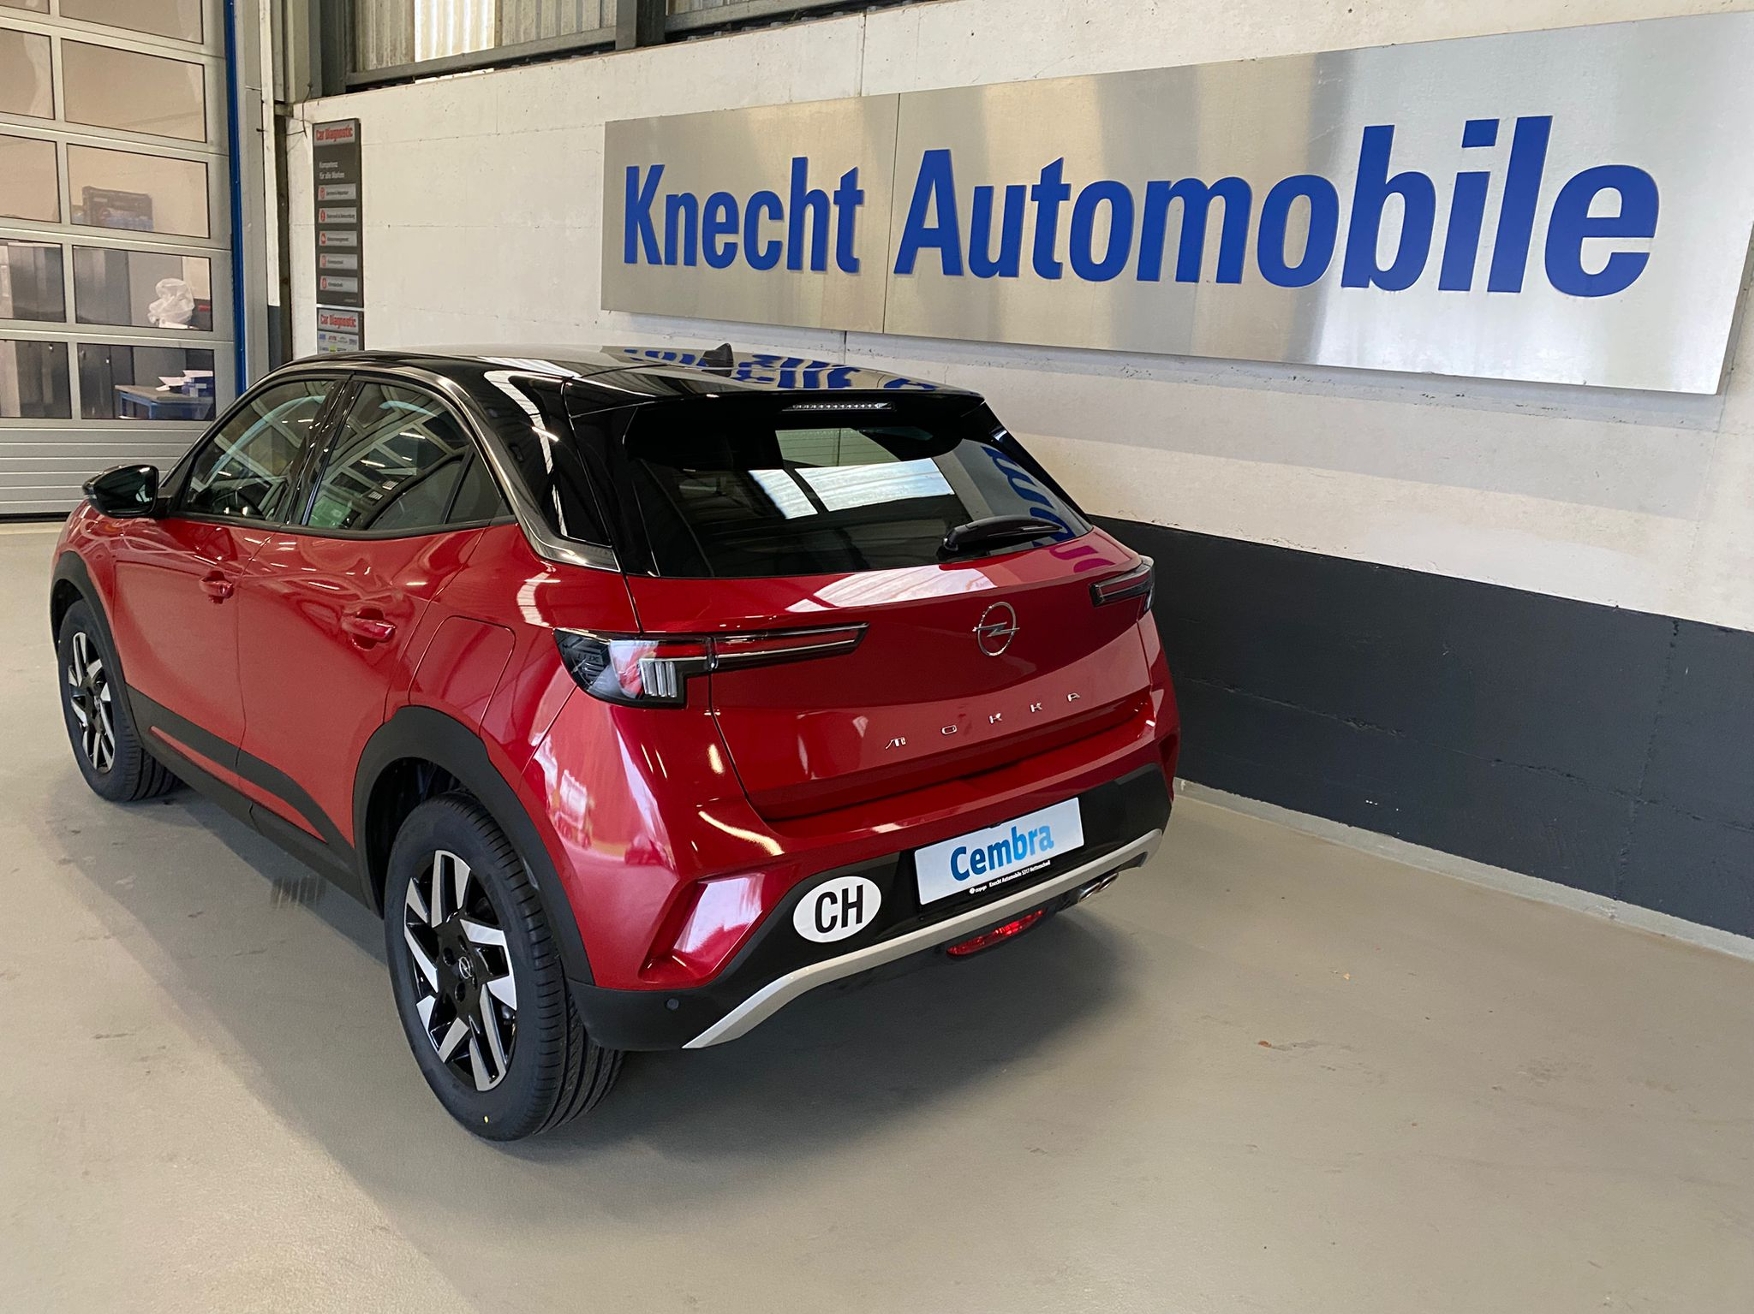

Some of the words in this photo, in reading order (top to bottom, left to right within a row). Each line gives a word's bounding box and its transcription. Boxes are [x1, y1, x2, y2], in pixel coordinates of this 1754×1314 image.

[315, 129, 325, 141] Car
[325, 124, 354, 142] Diagnostic
[623, 155, 866, 274] Knecht
[892, 114, 1661, 298] Automobile
[320, 313, 329, 325] Car
[329, 313, 357, 329] Diagnostic
[950, 824, 1055, 882] Cembra
[814, 884, 864, 934] CH
